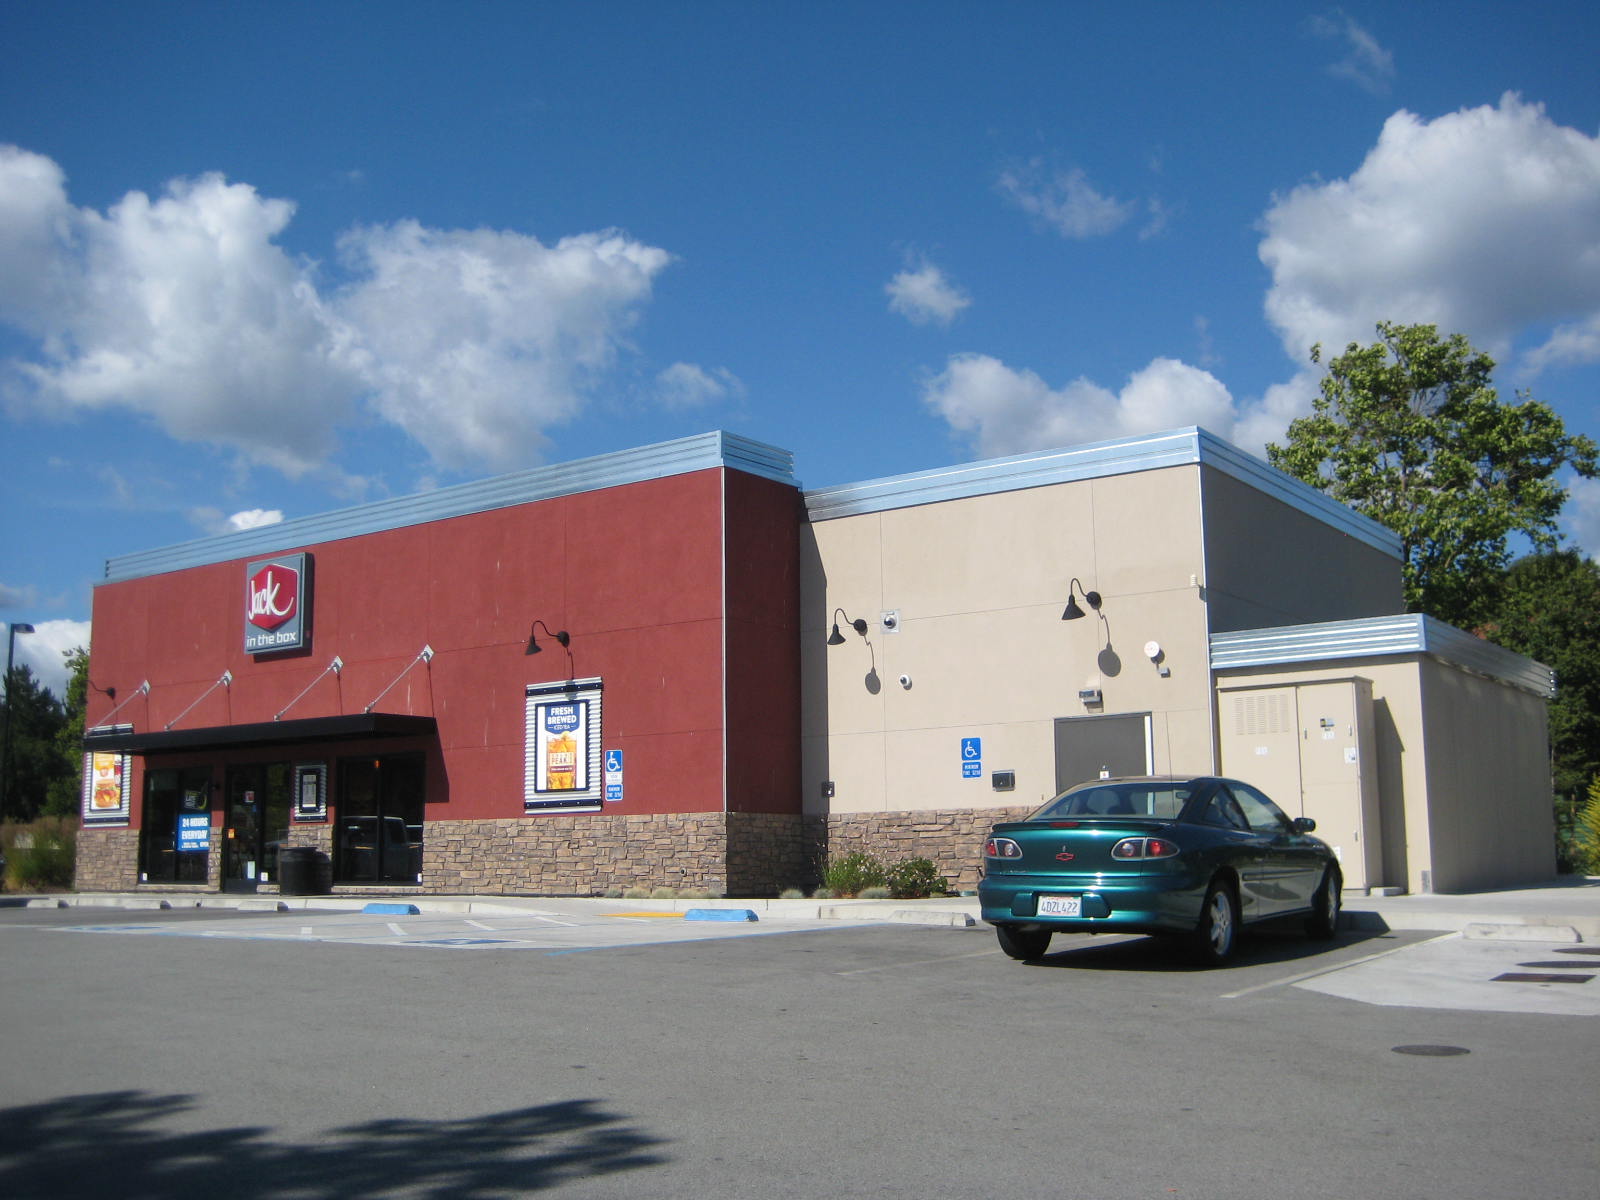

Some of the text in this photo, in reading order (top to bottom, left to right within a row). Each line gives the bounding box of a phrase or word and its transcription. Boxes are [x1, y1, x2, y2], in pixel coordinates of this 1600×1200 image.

[246, 632, 296, 647] in the box
[550, 706, 574, 716] FRESH
[547, 715, 577, 725] BREWED
[182, 817, 209, 828] 24 HOURS
[181, 829, 208, 840] EVERYDAY
[1041, 902, 1078, 913] 4DZL422
